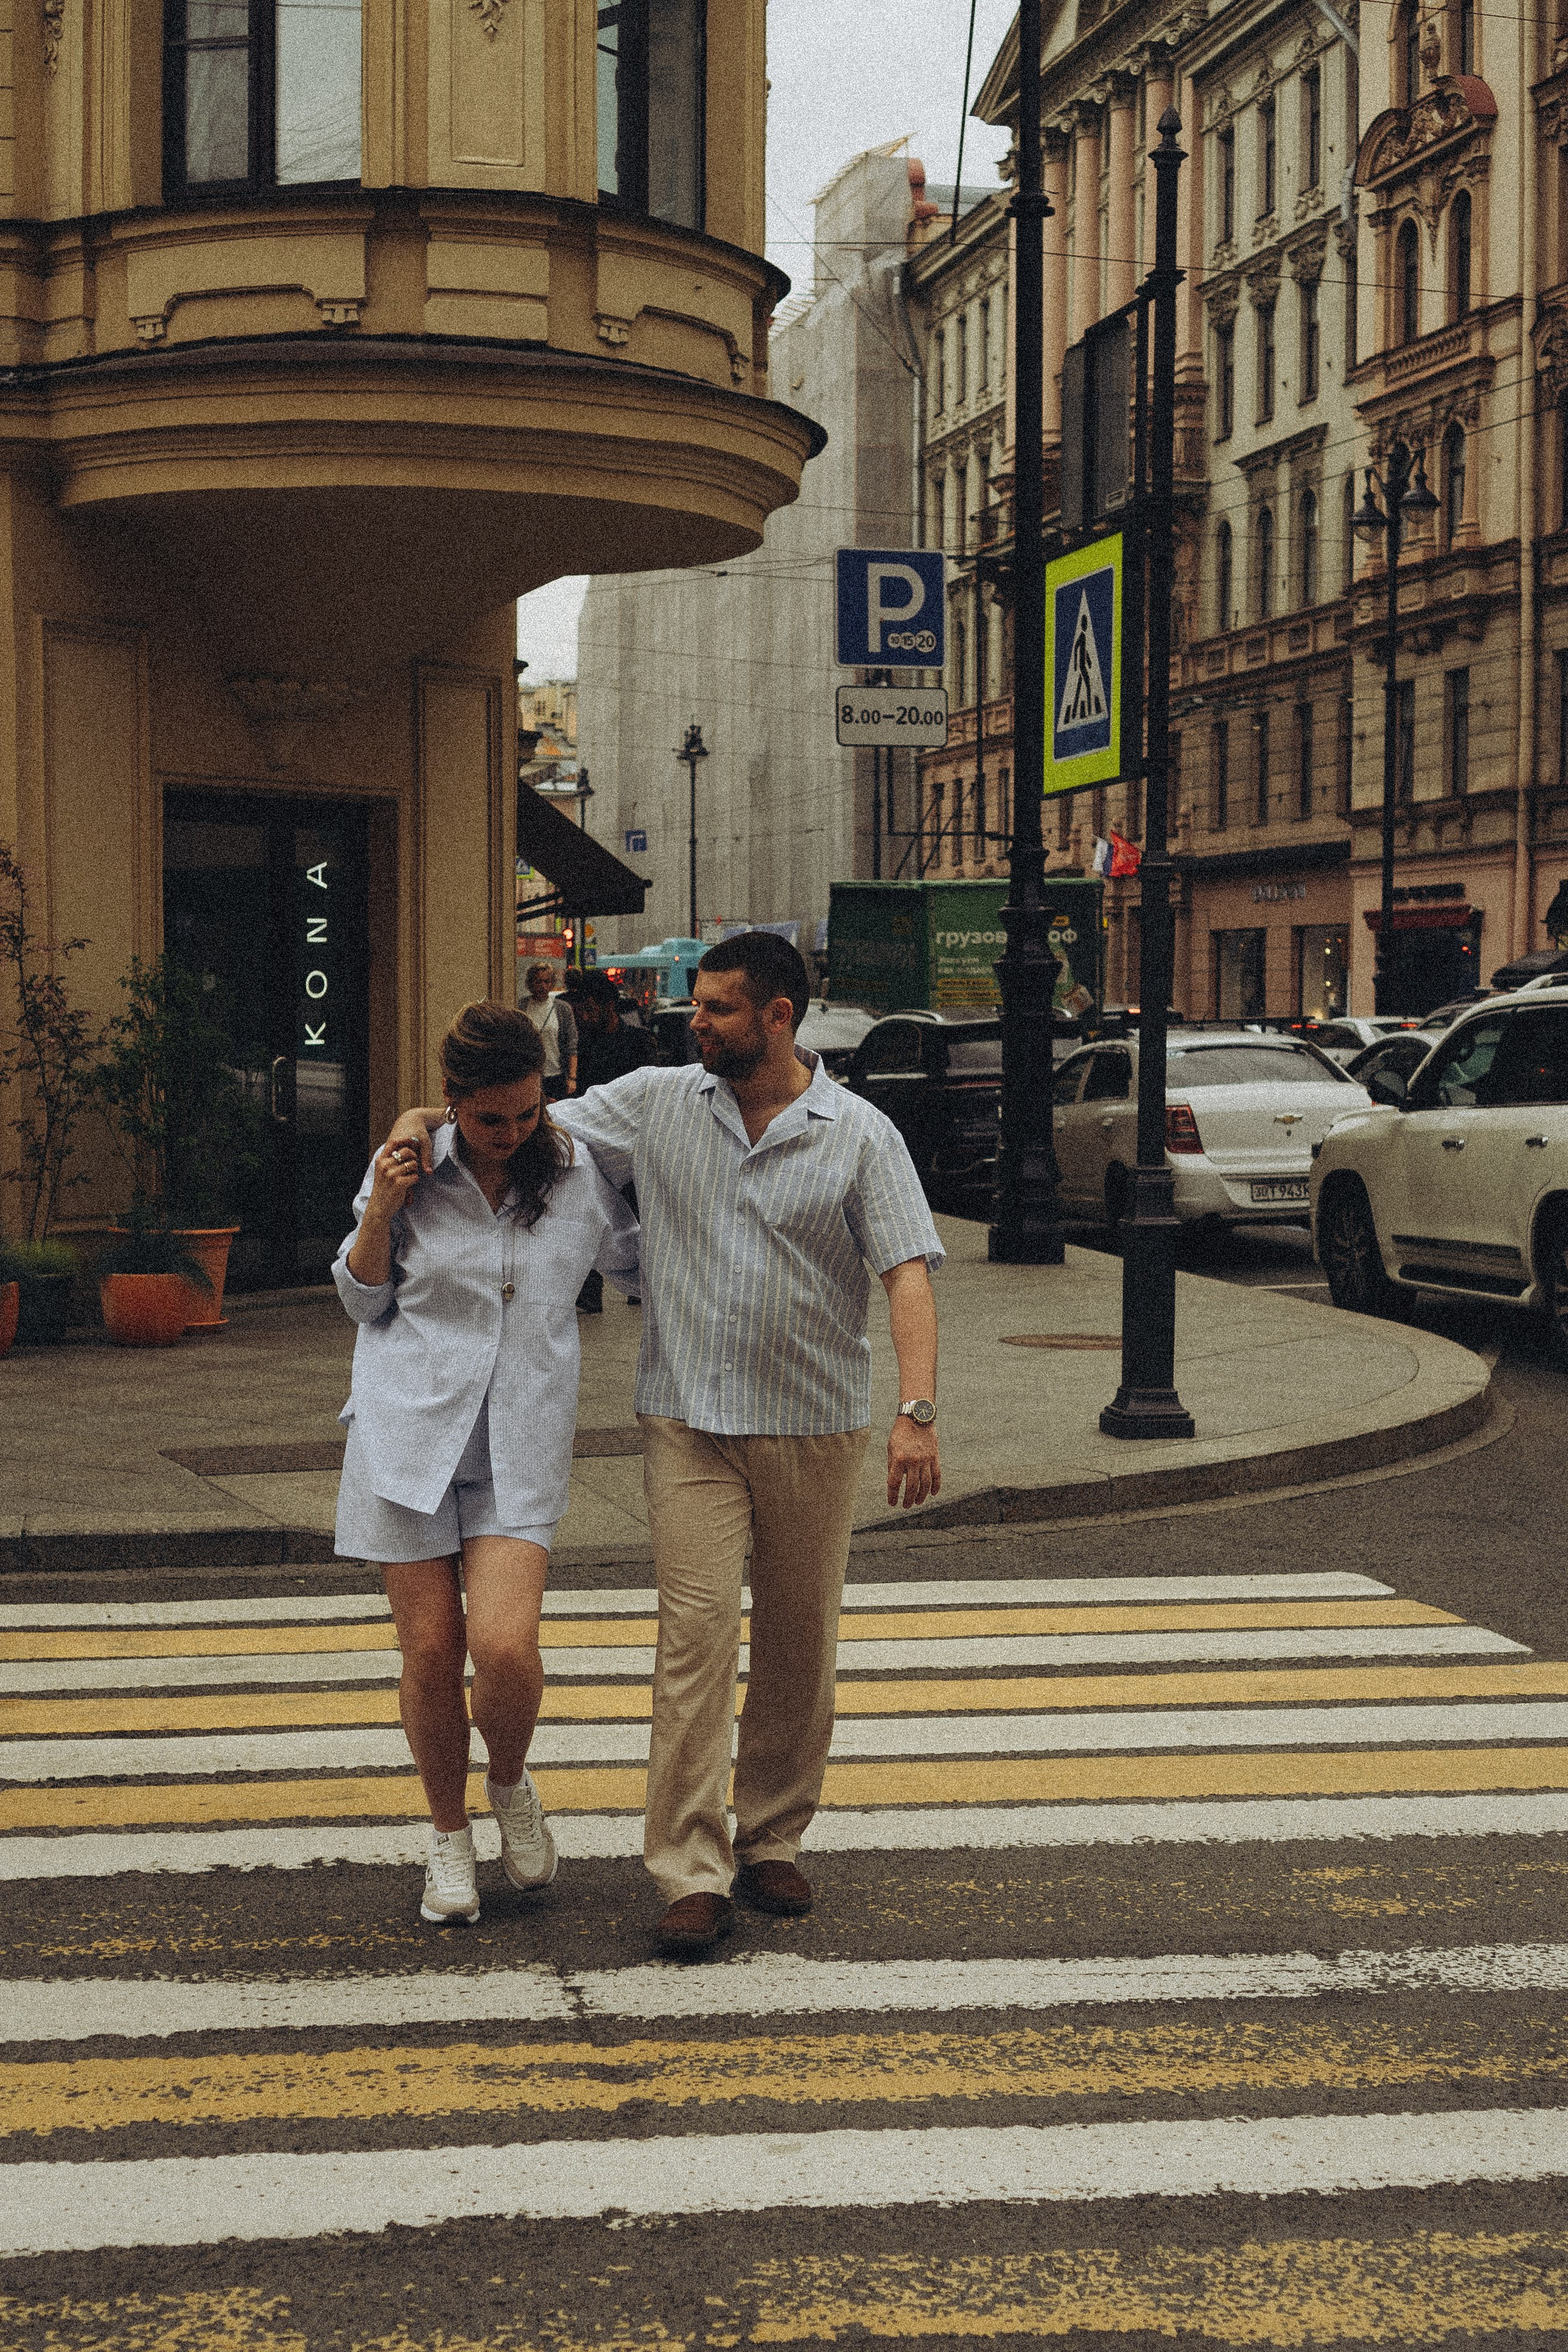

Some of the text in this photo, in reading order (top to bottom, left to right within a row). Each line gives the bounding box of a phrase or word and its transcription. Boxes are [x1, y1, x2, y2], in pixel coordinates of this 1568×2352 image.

[867, 562, 925, 653] P
[918, 635, 935, 647] 20
[841, 704, 944, 725] 8.00-20.00
[936, 927, 1079, 949] грузовоф
[304, 861, 328, 1046] KONA
